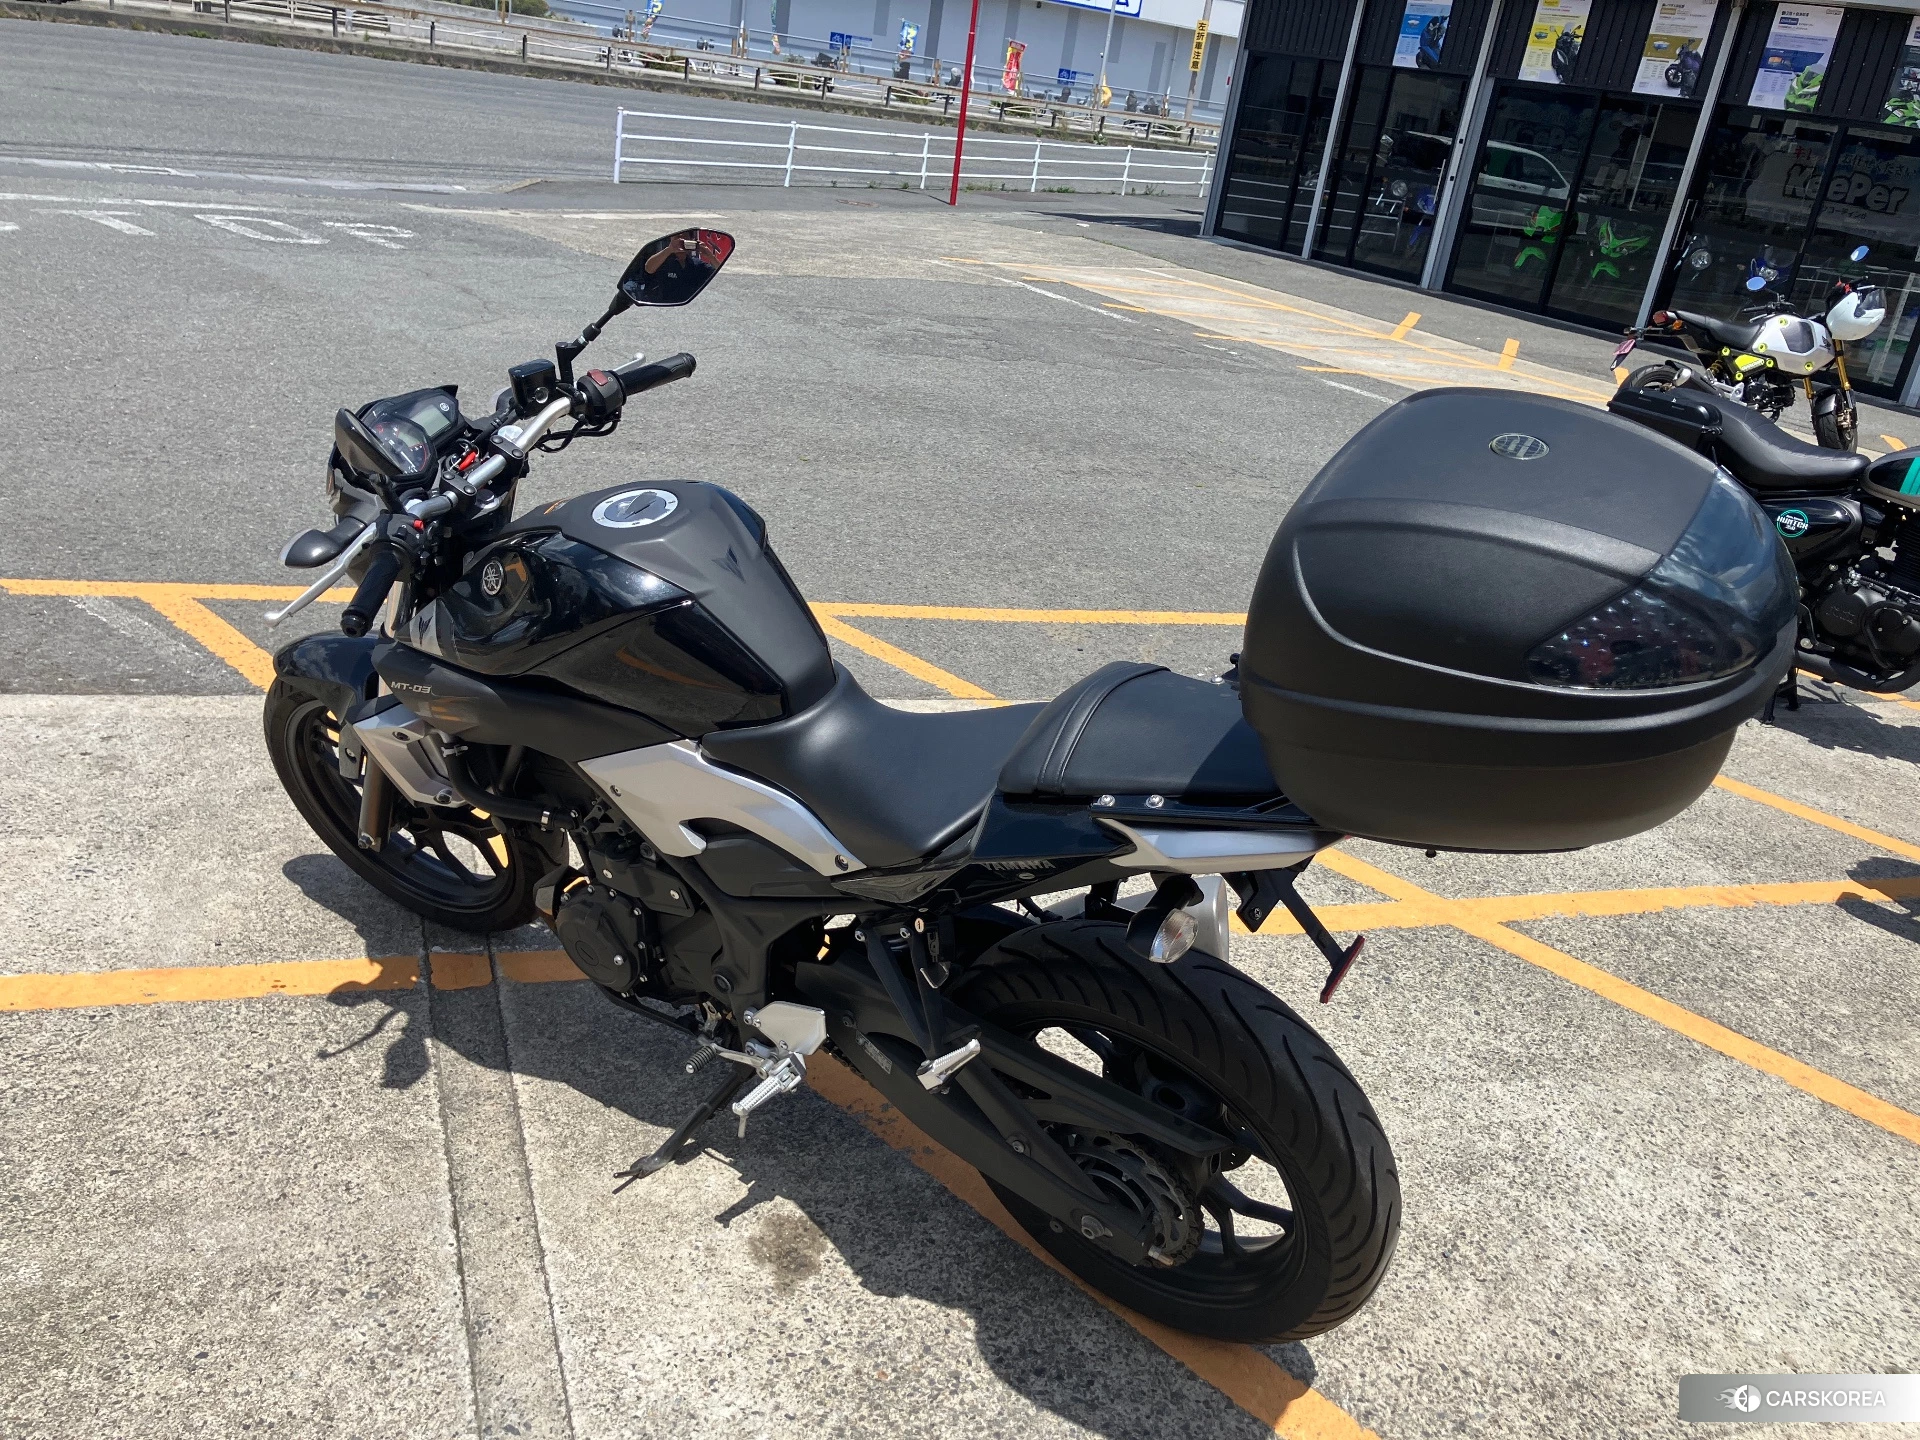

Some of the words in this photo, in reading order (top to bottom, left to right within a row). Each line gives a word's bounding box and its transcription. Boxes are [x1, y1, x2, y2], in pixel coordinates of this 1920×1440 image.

[1190, 21, 1208, 70] 左折車注意
[0, 208, 416, 250] TOP
[1776, 515, 1809, 530] HUNTER
[391, 681, 433, 694] MT-03
[980, 859, 1057, 871] YAMAHA
